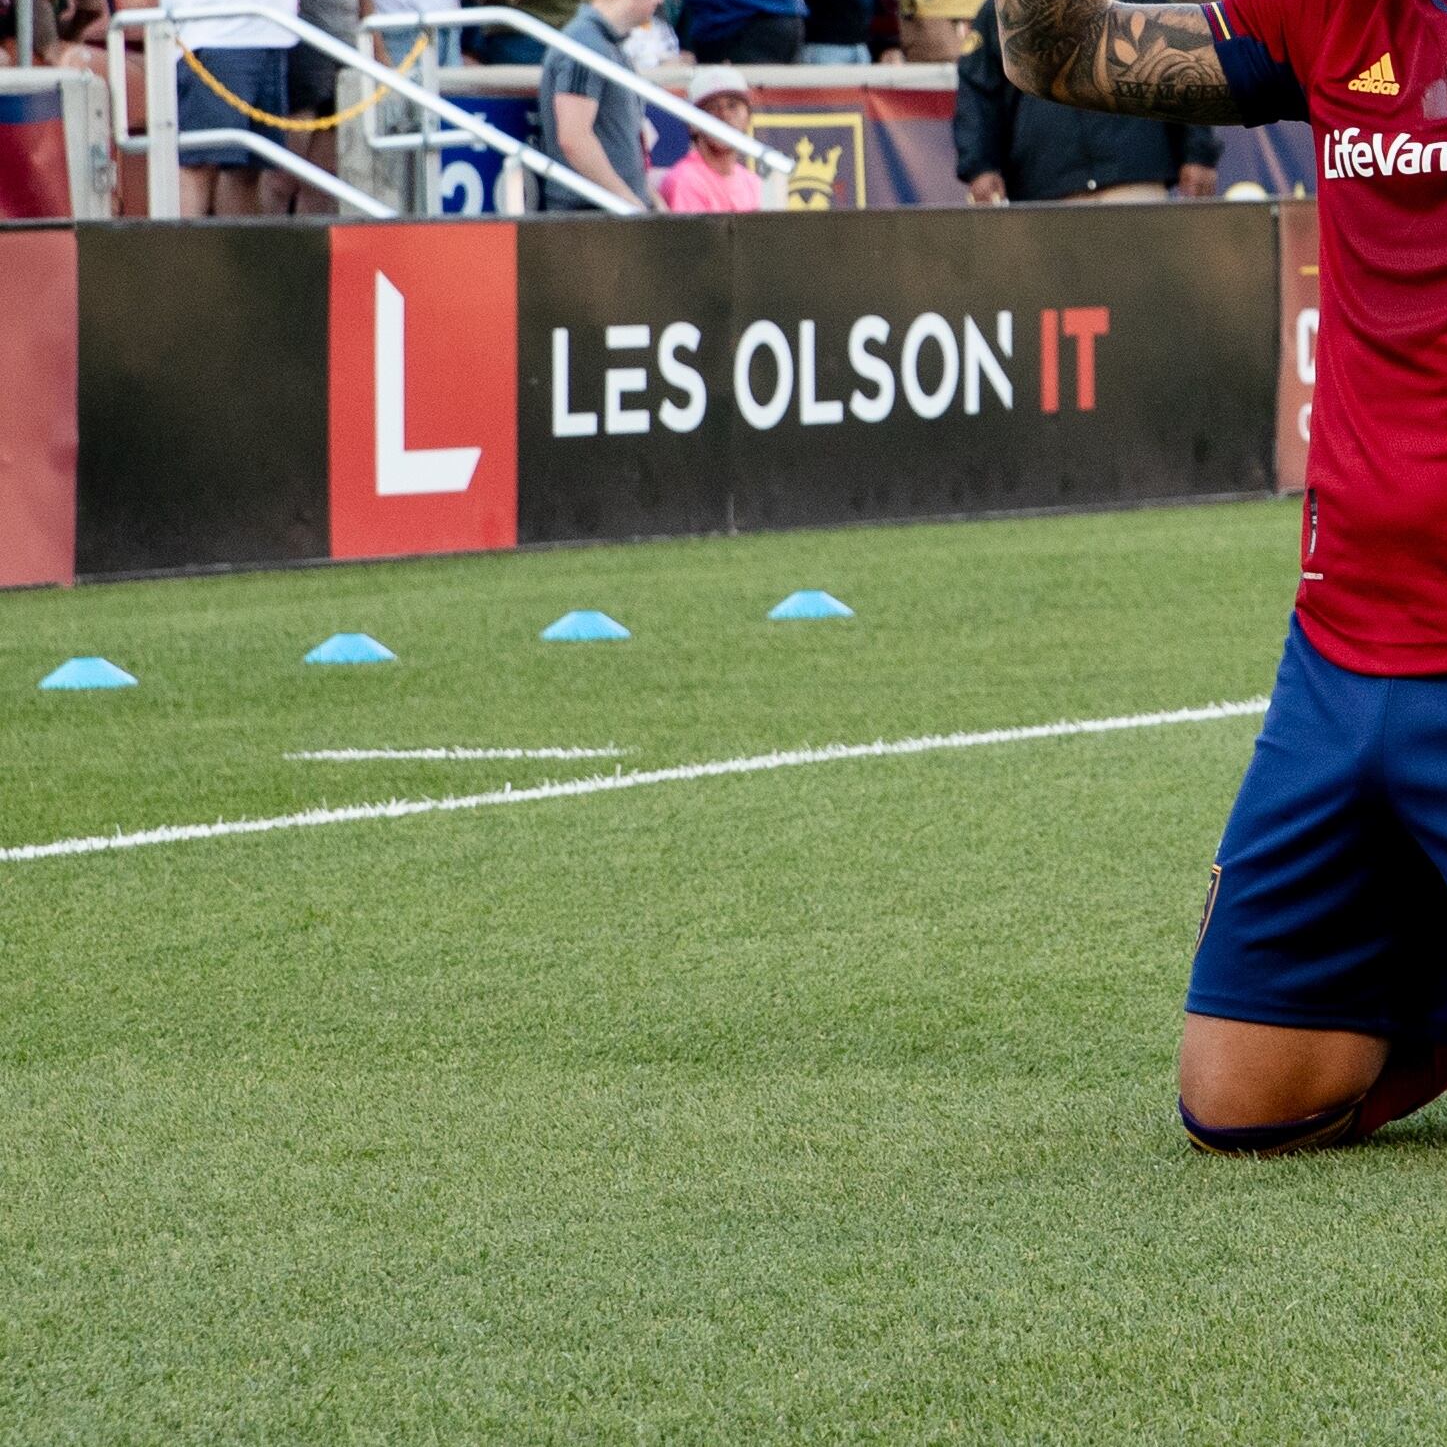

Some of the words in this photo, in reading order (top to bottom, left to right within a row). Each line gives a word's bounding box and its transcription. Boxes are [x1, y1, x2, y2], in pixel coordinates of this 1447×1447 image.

[1348, 78, 1400, 96] adidas
[552, 321, 707, 437] LES
[733, 310, 1013, 430] OLSON
[1039, 306, 1110, 413] IT
